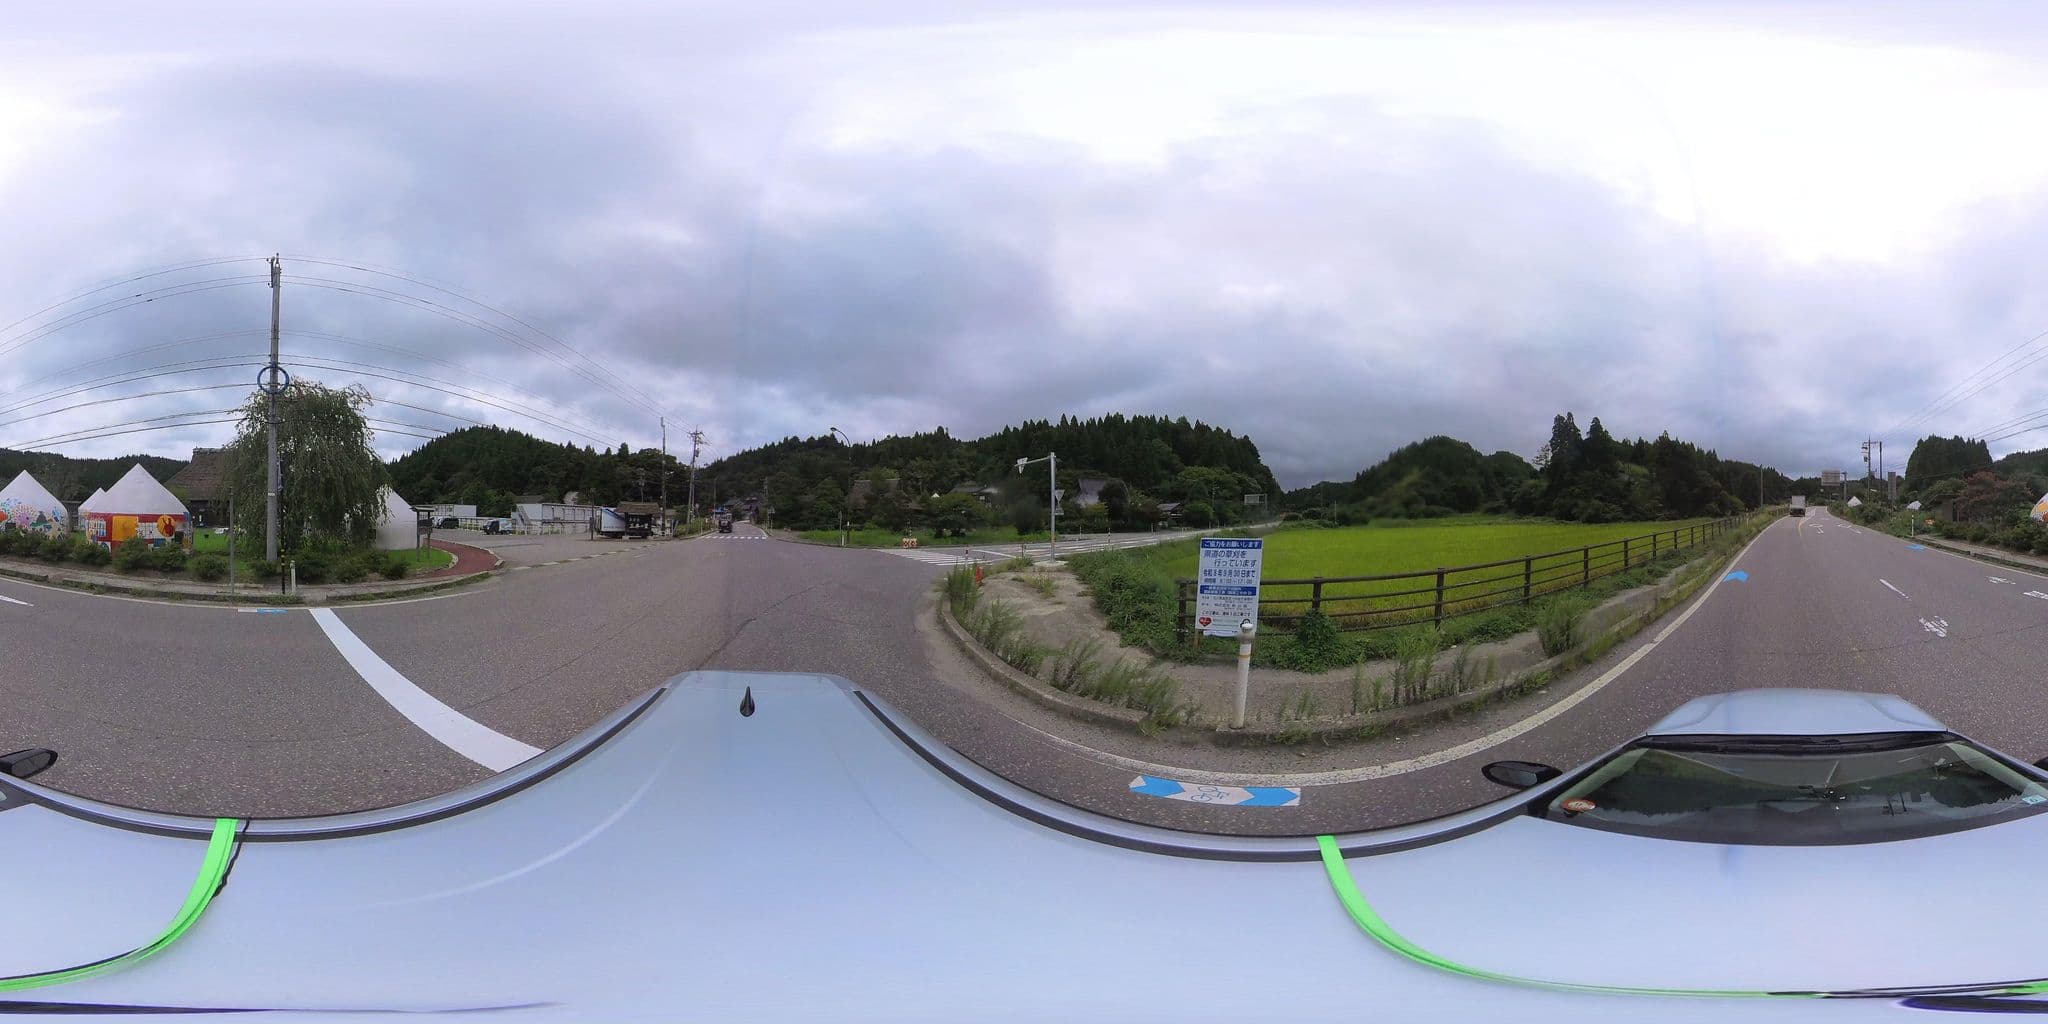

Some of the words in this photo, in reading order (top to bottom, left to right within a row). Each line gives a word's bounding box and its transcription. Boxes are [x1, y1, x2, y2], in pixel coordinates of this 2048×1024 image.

[1214, 559, 1257, 568] 行っています
